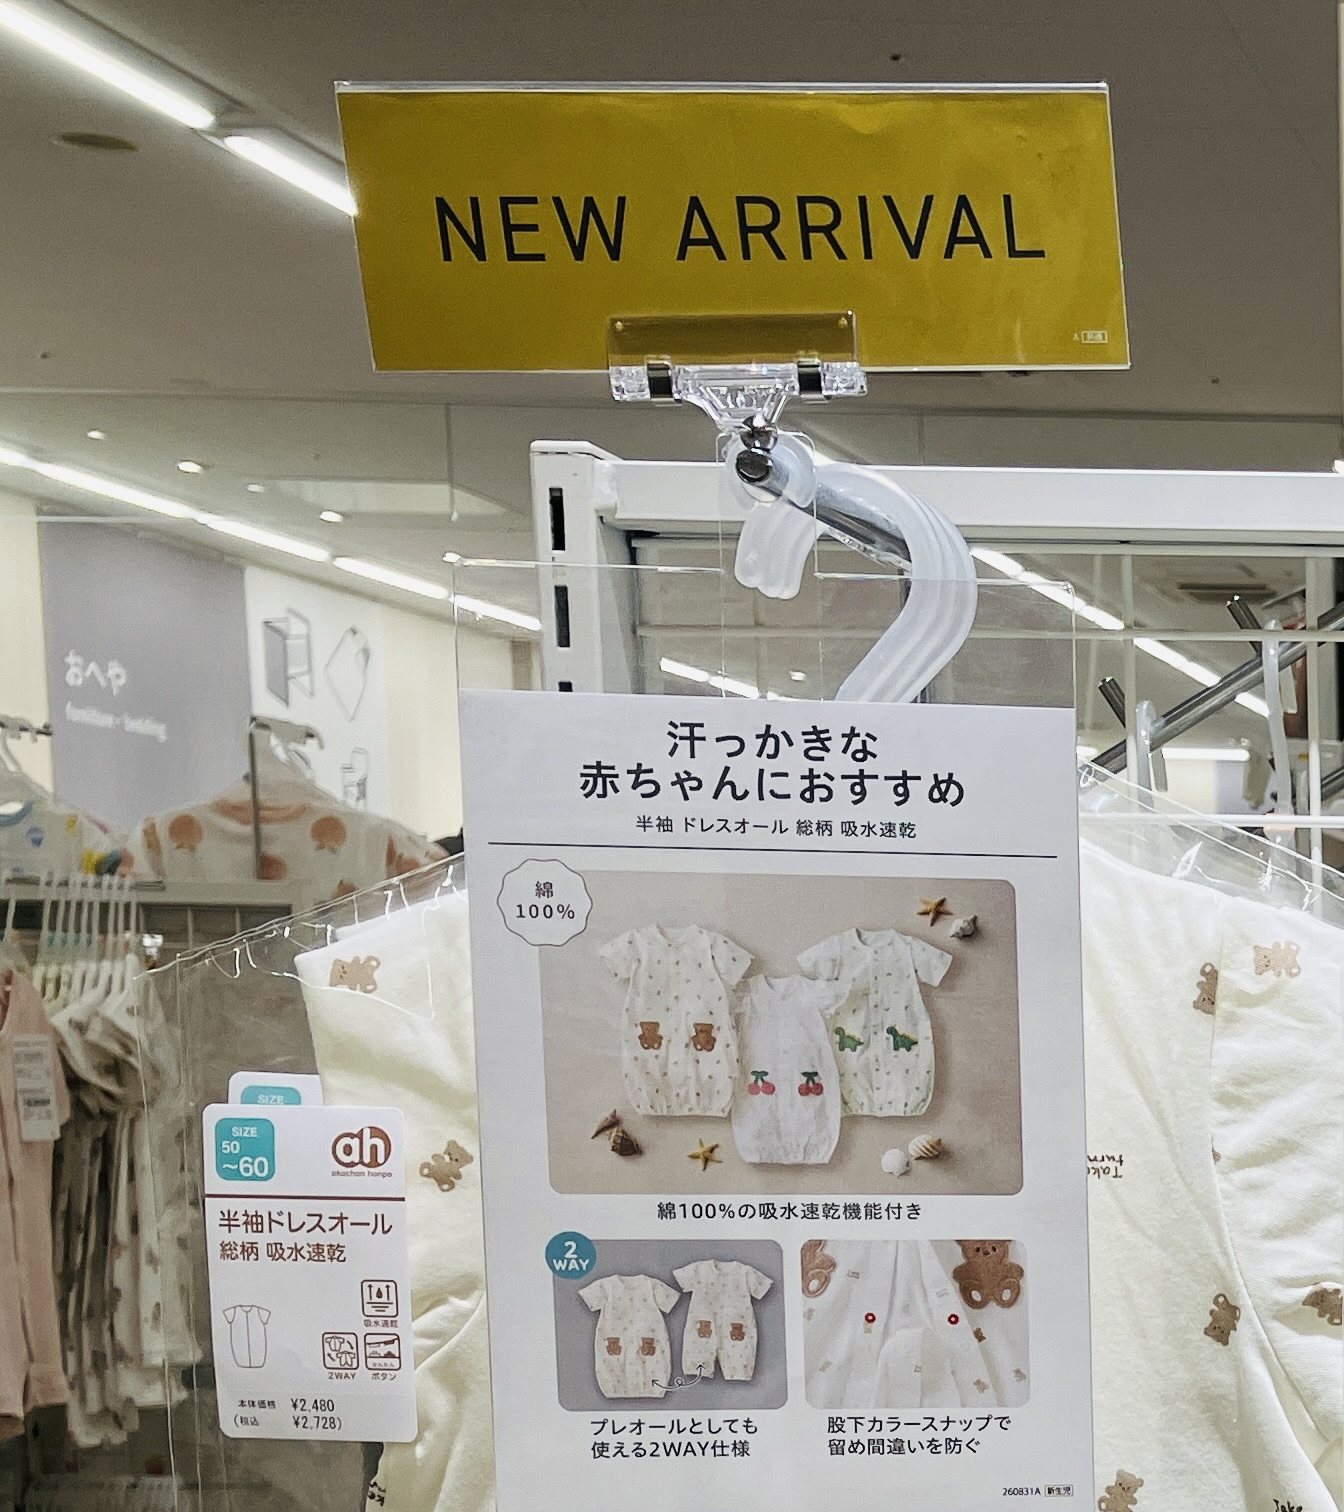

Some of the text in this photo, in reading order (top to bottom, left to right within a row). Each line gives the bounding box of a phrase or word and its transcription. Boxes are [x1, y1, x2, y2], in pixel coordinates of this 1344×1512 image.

[433, 192, 1046, 264] NEW ARRIVAL
[64, 650, 128, 696] おへや
[666, 720, 880, 763] 汗っかきな
[579, 760, 966, 809] 赤ちゃんにおすすめ
[635, 814, 918, 841] 半袖 ドレスオール 総柄 吸水速乾
[534, 880, 555, 901] 綿
[514, 902, 577, 922] 100%
[231, 1126, 258, 1138] SIZE
[221, 1141, 241, 1155] 50
[331, 1125, 393, 1169] ah
[656, 1201, 924, 1223] 綿100%の吸水速乾機能付き
[218, 1209, 394, 1237] 半袖ドレスオール
[219, 1240, 347, 1265] 総柄 吸水速乾
[563, 1241, 578, 1259] 2
[551, 1256, 591, 1274] WAY
[327, 1372, 357, 1381] 2WAY
[589, 1416, 760, 1437] プレオールとしても
[826, 1413, 1013, 1435] 股下カラースナップで
[590, 1439, 752, 1460] 使える2WAY仕様
[827, 1437, 982, 1458] 留め間違いを防ぐ
